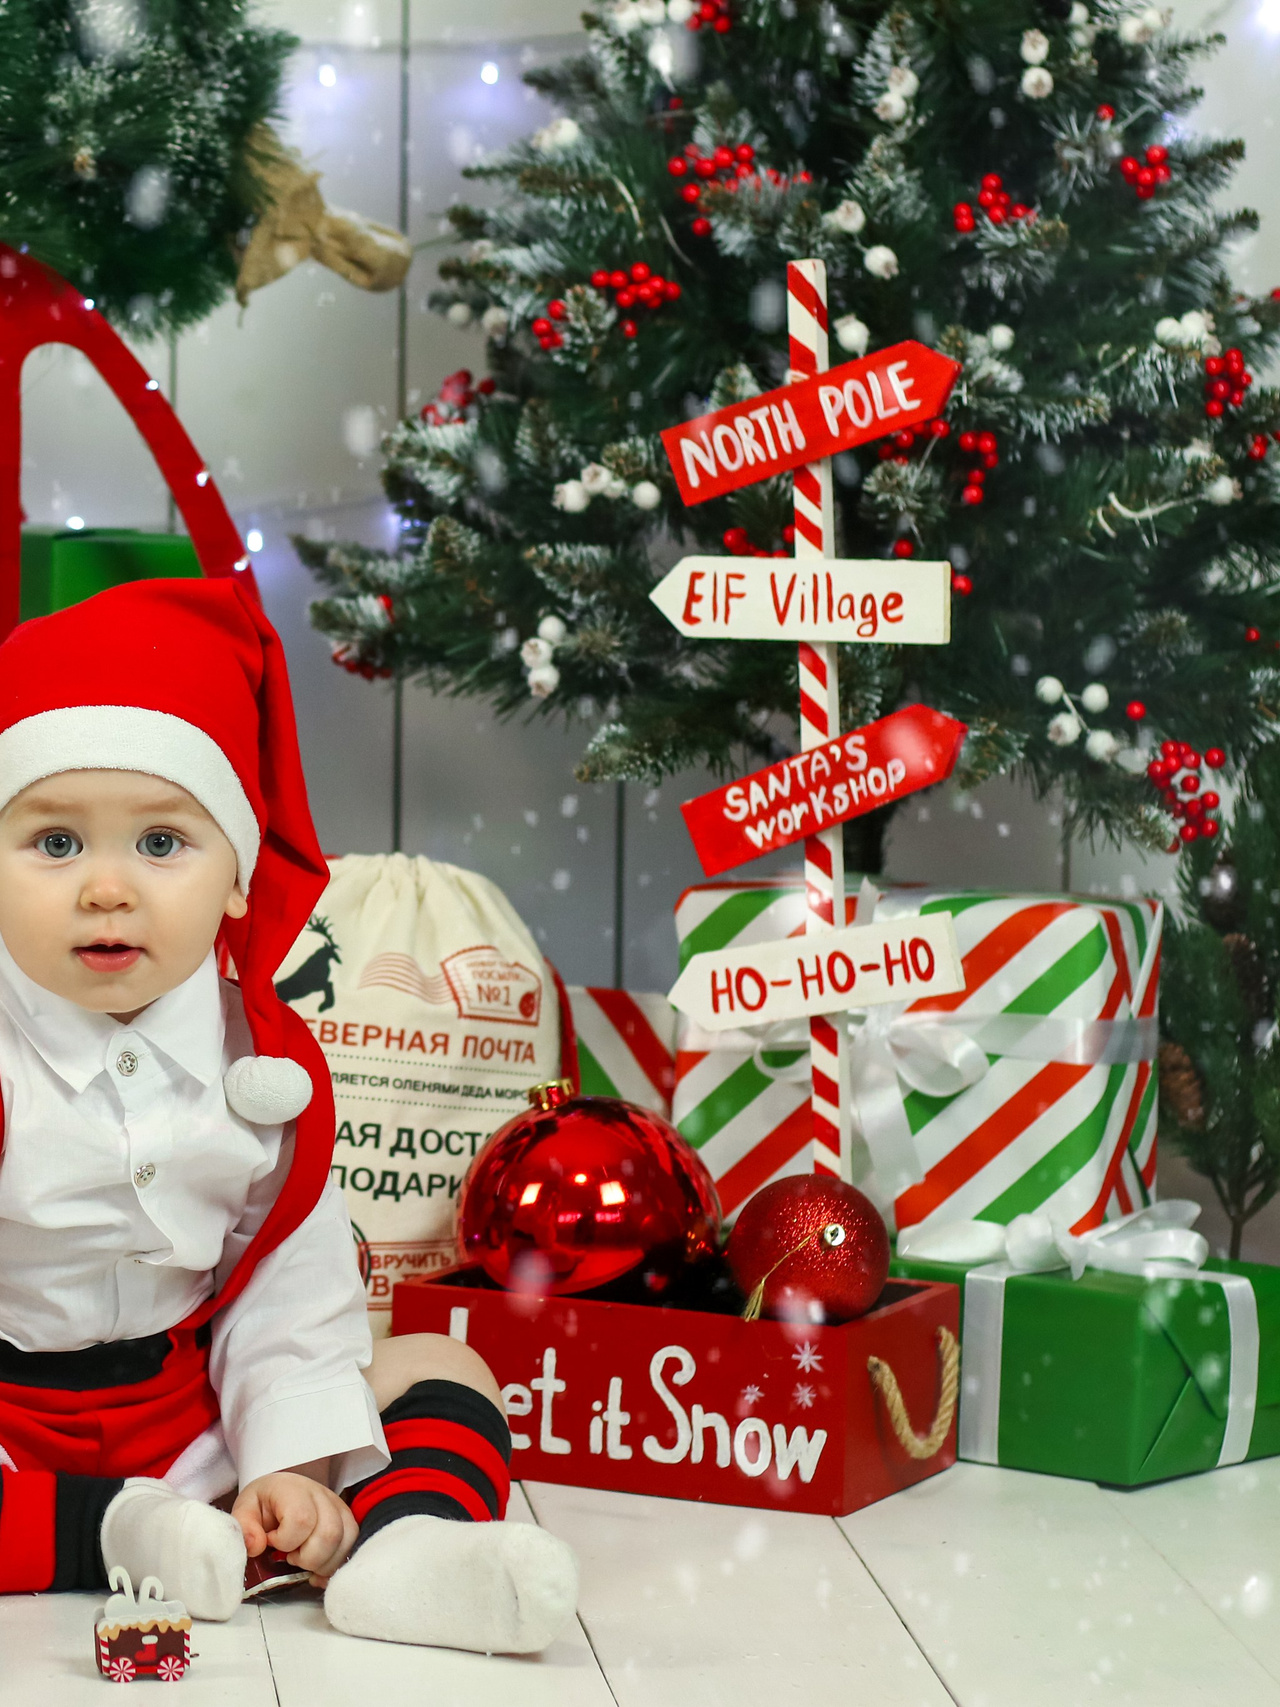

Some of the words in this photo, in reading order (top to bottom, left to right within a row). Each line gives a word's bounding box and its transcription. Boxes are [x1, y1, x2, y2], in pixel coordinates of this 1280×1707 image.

[679, 399, 806, 488] NORTH
[818, 360, 922, 438] POLE
[770, 572, 905, 638] Village
[723, 735, 869, 822] SANTA'S
[710, 937, 935, 1014] HO-HO-HO
[462, 1034, 536, 1065] ПОЧТА
[392, 1078, 460, 1095] ОЛЕНЯМИ
[461, 1084, 492, 1099] ДЕДА
[389, 1127, 492, 1159] ДОСТ
[370, 1252, 451, 1270] ВРУЧИТЬ
[589, 1377, 633, 1460] it
[643, 1345, 827, 1483] Snow
